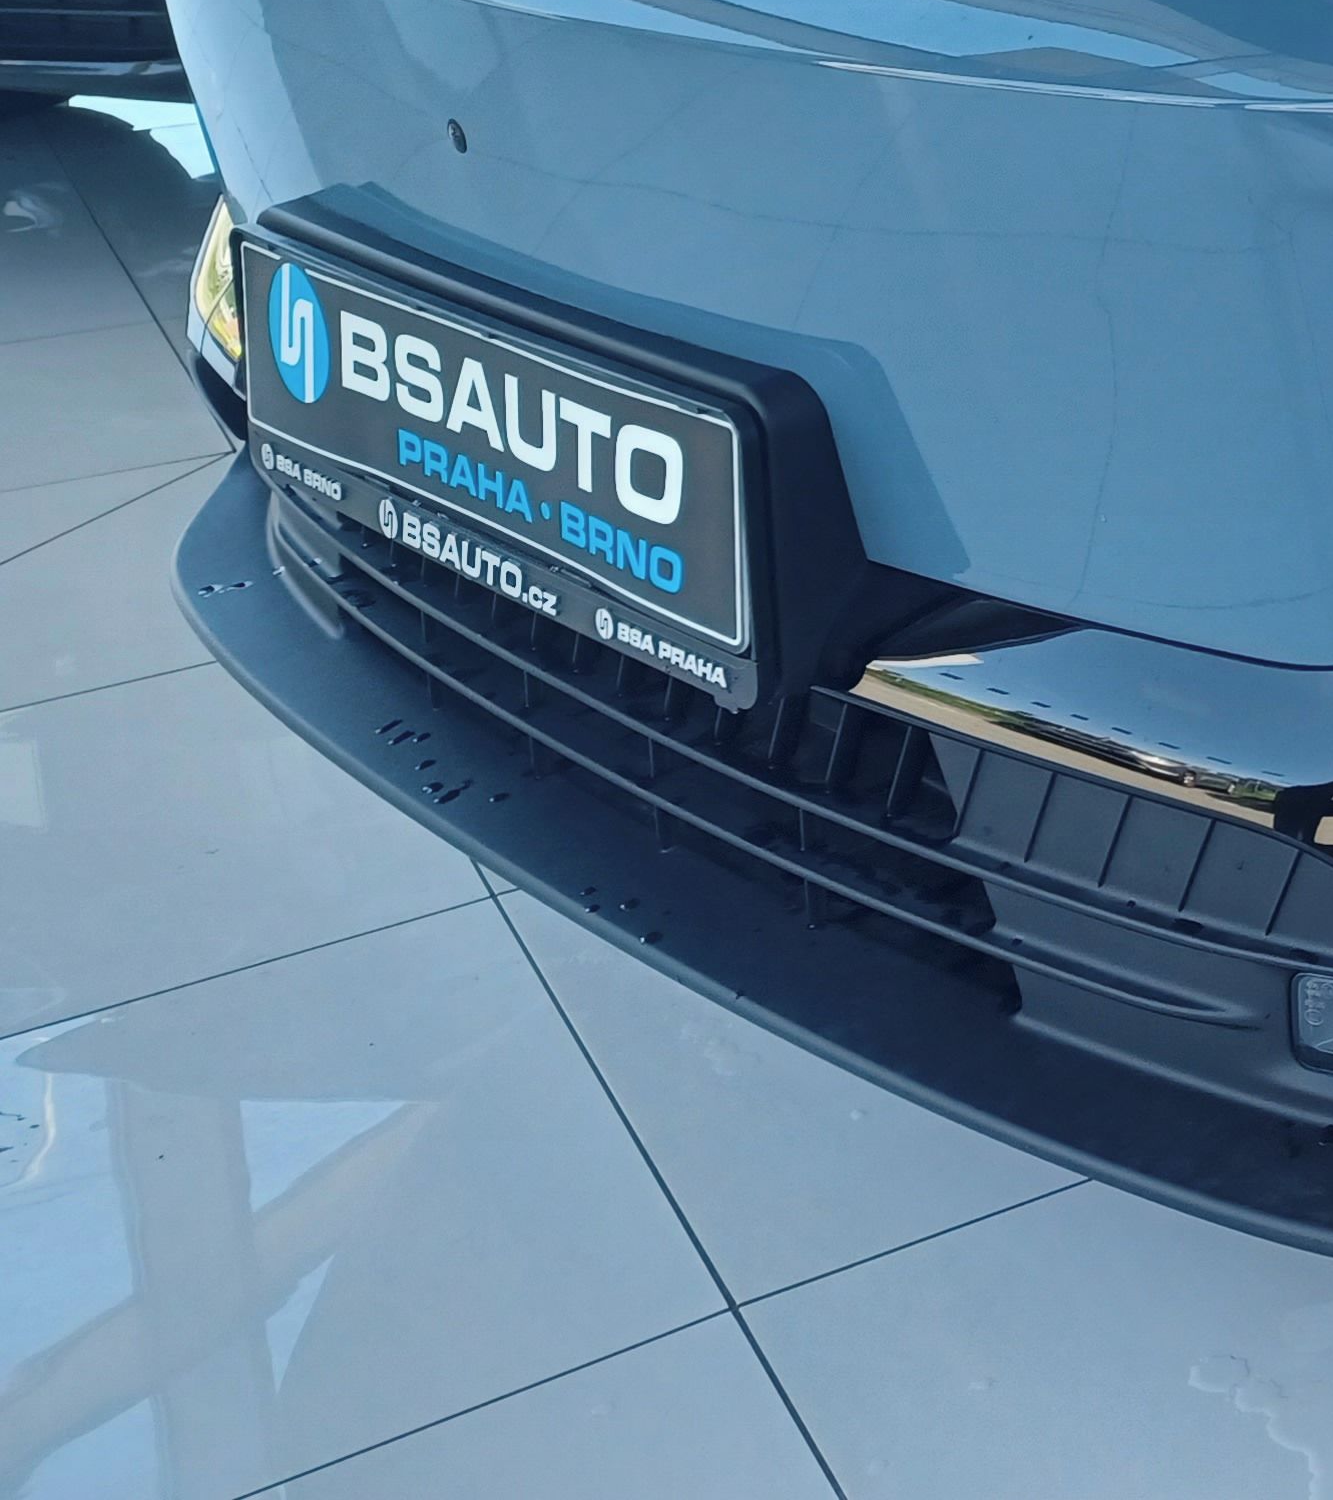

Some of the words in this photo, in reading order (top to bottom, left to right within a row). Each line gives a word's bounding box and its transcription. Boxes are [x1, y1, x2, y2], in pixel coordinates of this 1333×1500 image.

[340, 311, 684, 524] BSAUTO
[276, 454, 302, 482] BSA
[303, 468, 342, 501] BRNO
[398, 428, 533, 522] PRAHA
[559, 501, 683, 594] BRNO
[617, 623, 655, 655] BSA
[658, 642, 727, 689] PRAHA
